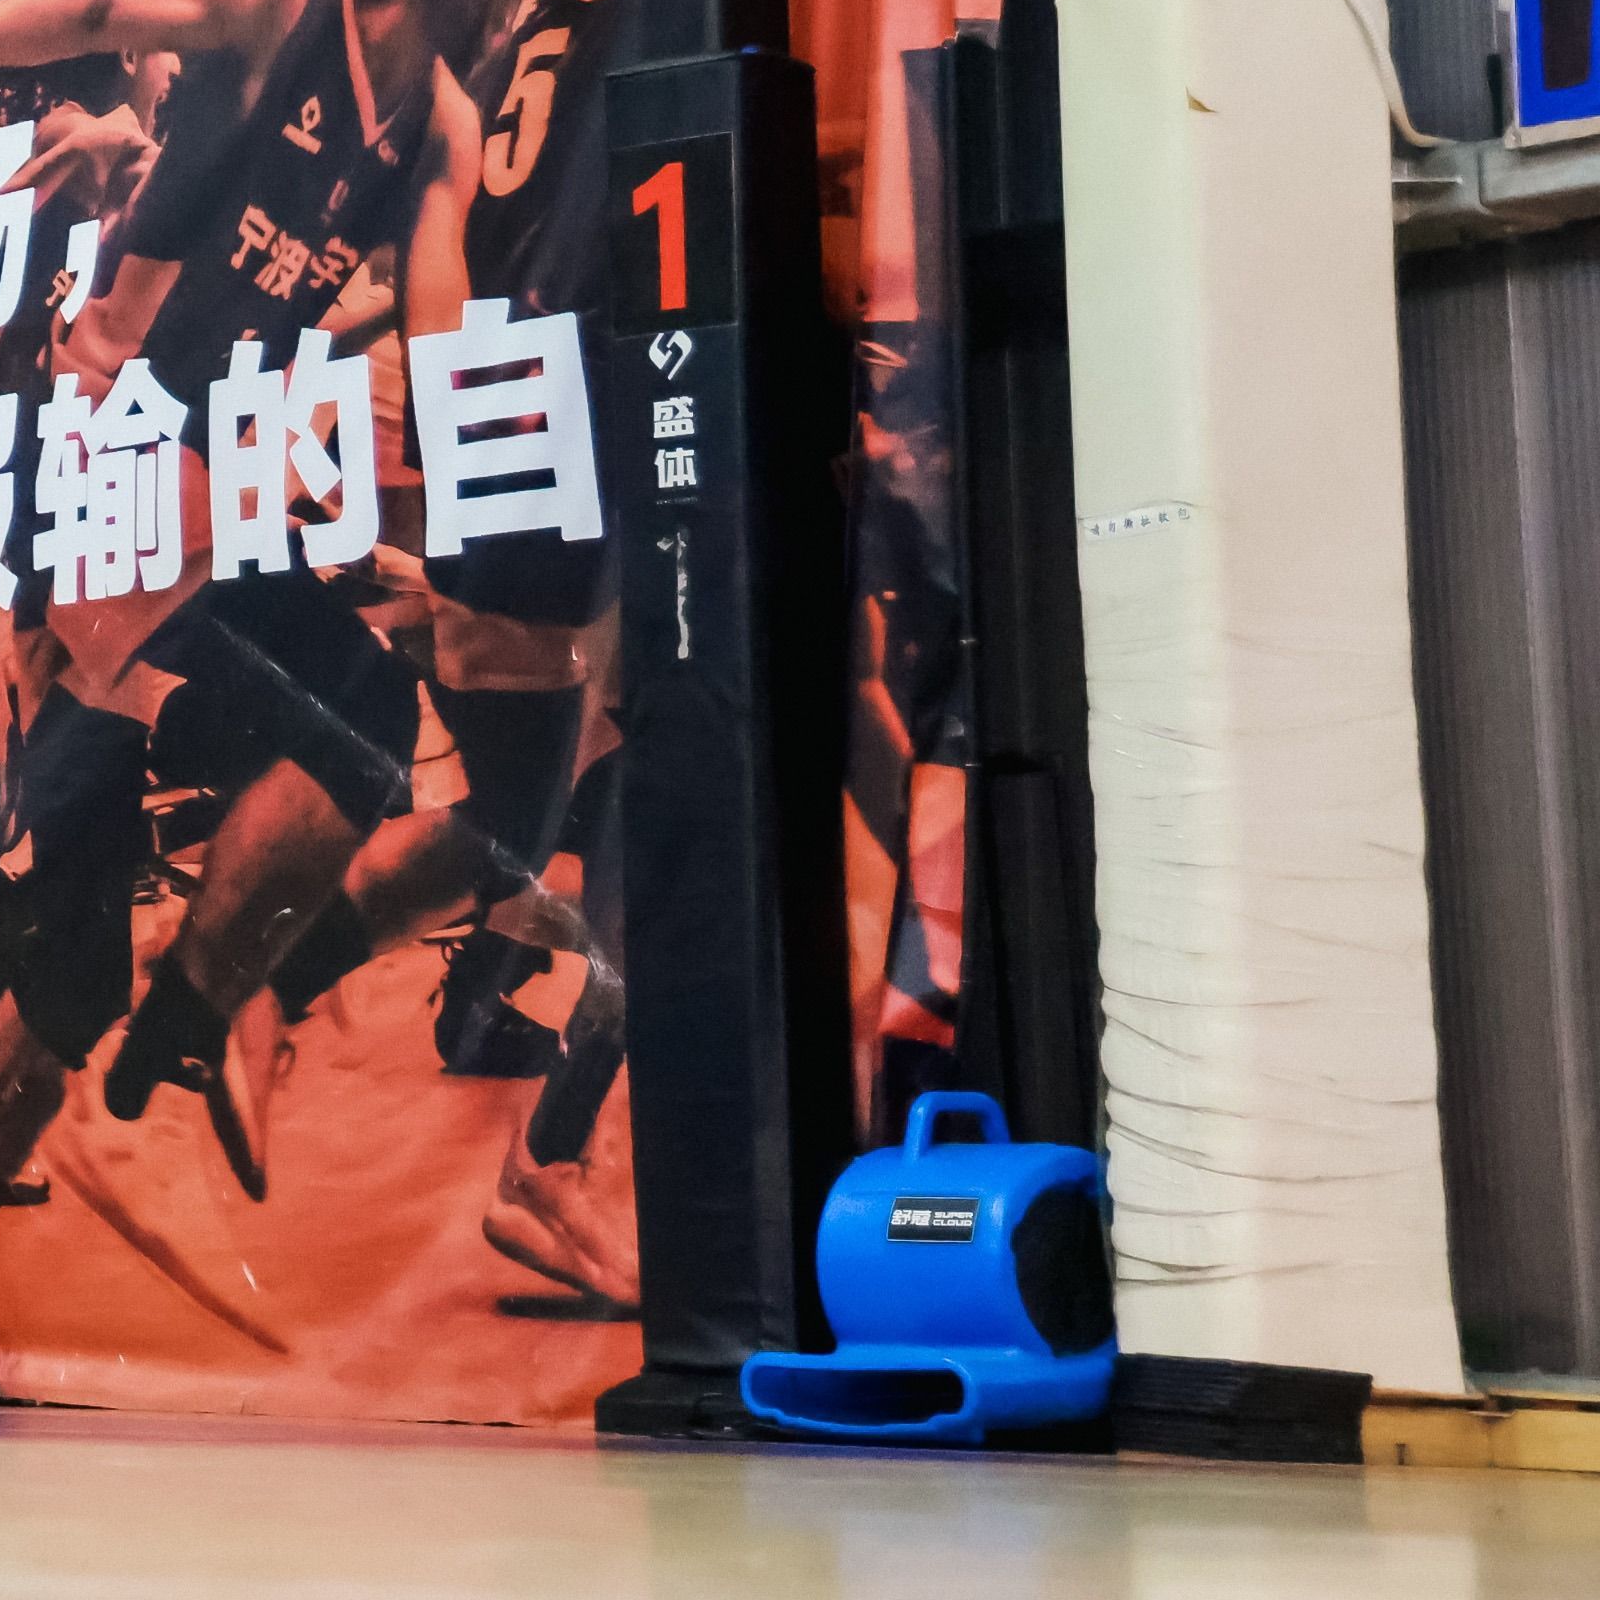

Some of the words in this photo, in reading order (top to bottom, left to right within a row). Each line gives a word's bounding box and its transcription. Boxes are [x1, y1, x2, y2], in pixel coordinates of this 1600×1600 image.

[632, 161, 687, 311] 1
[652, 395, 697, 489] 盛体
[932, 1219, 973, 1227] CLOUD
